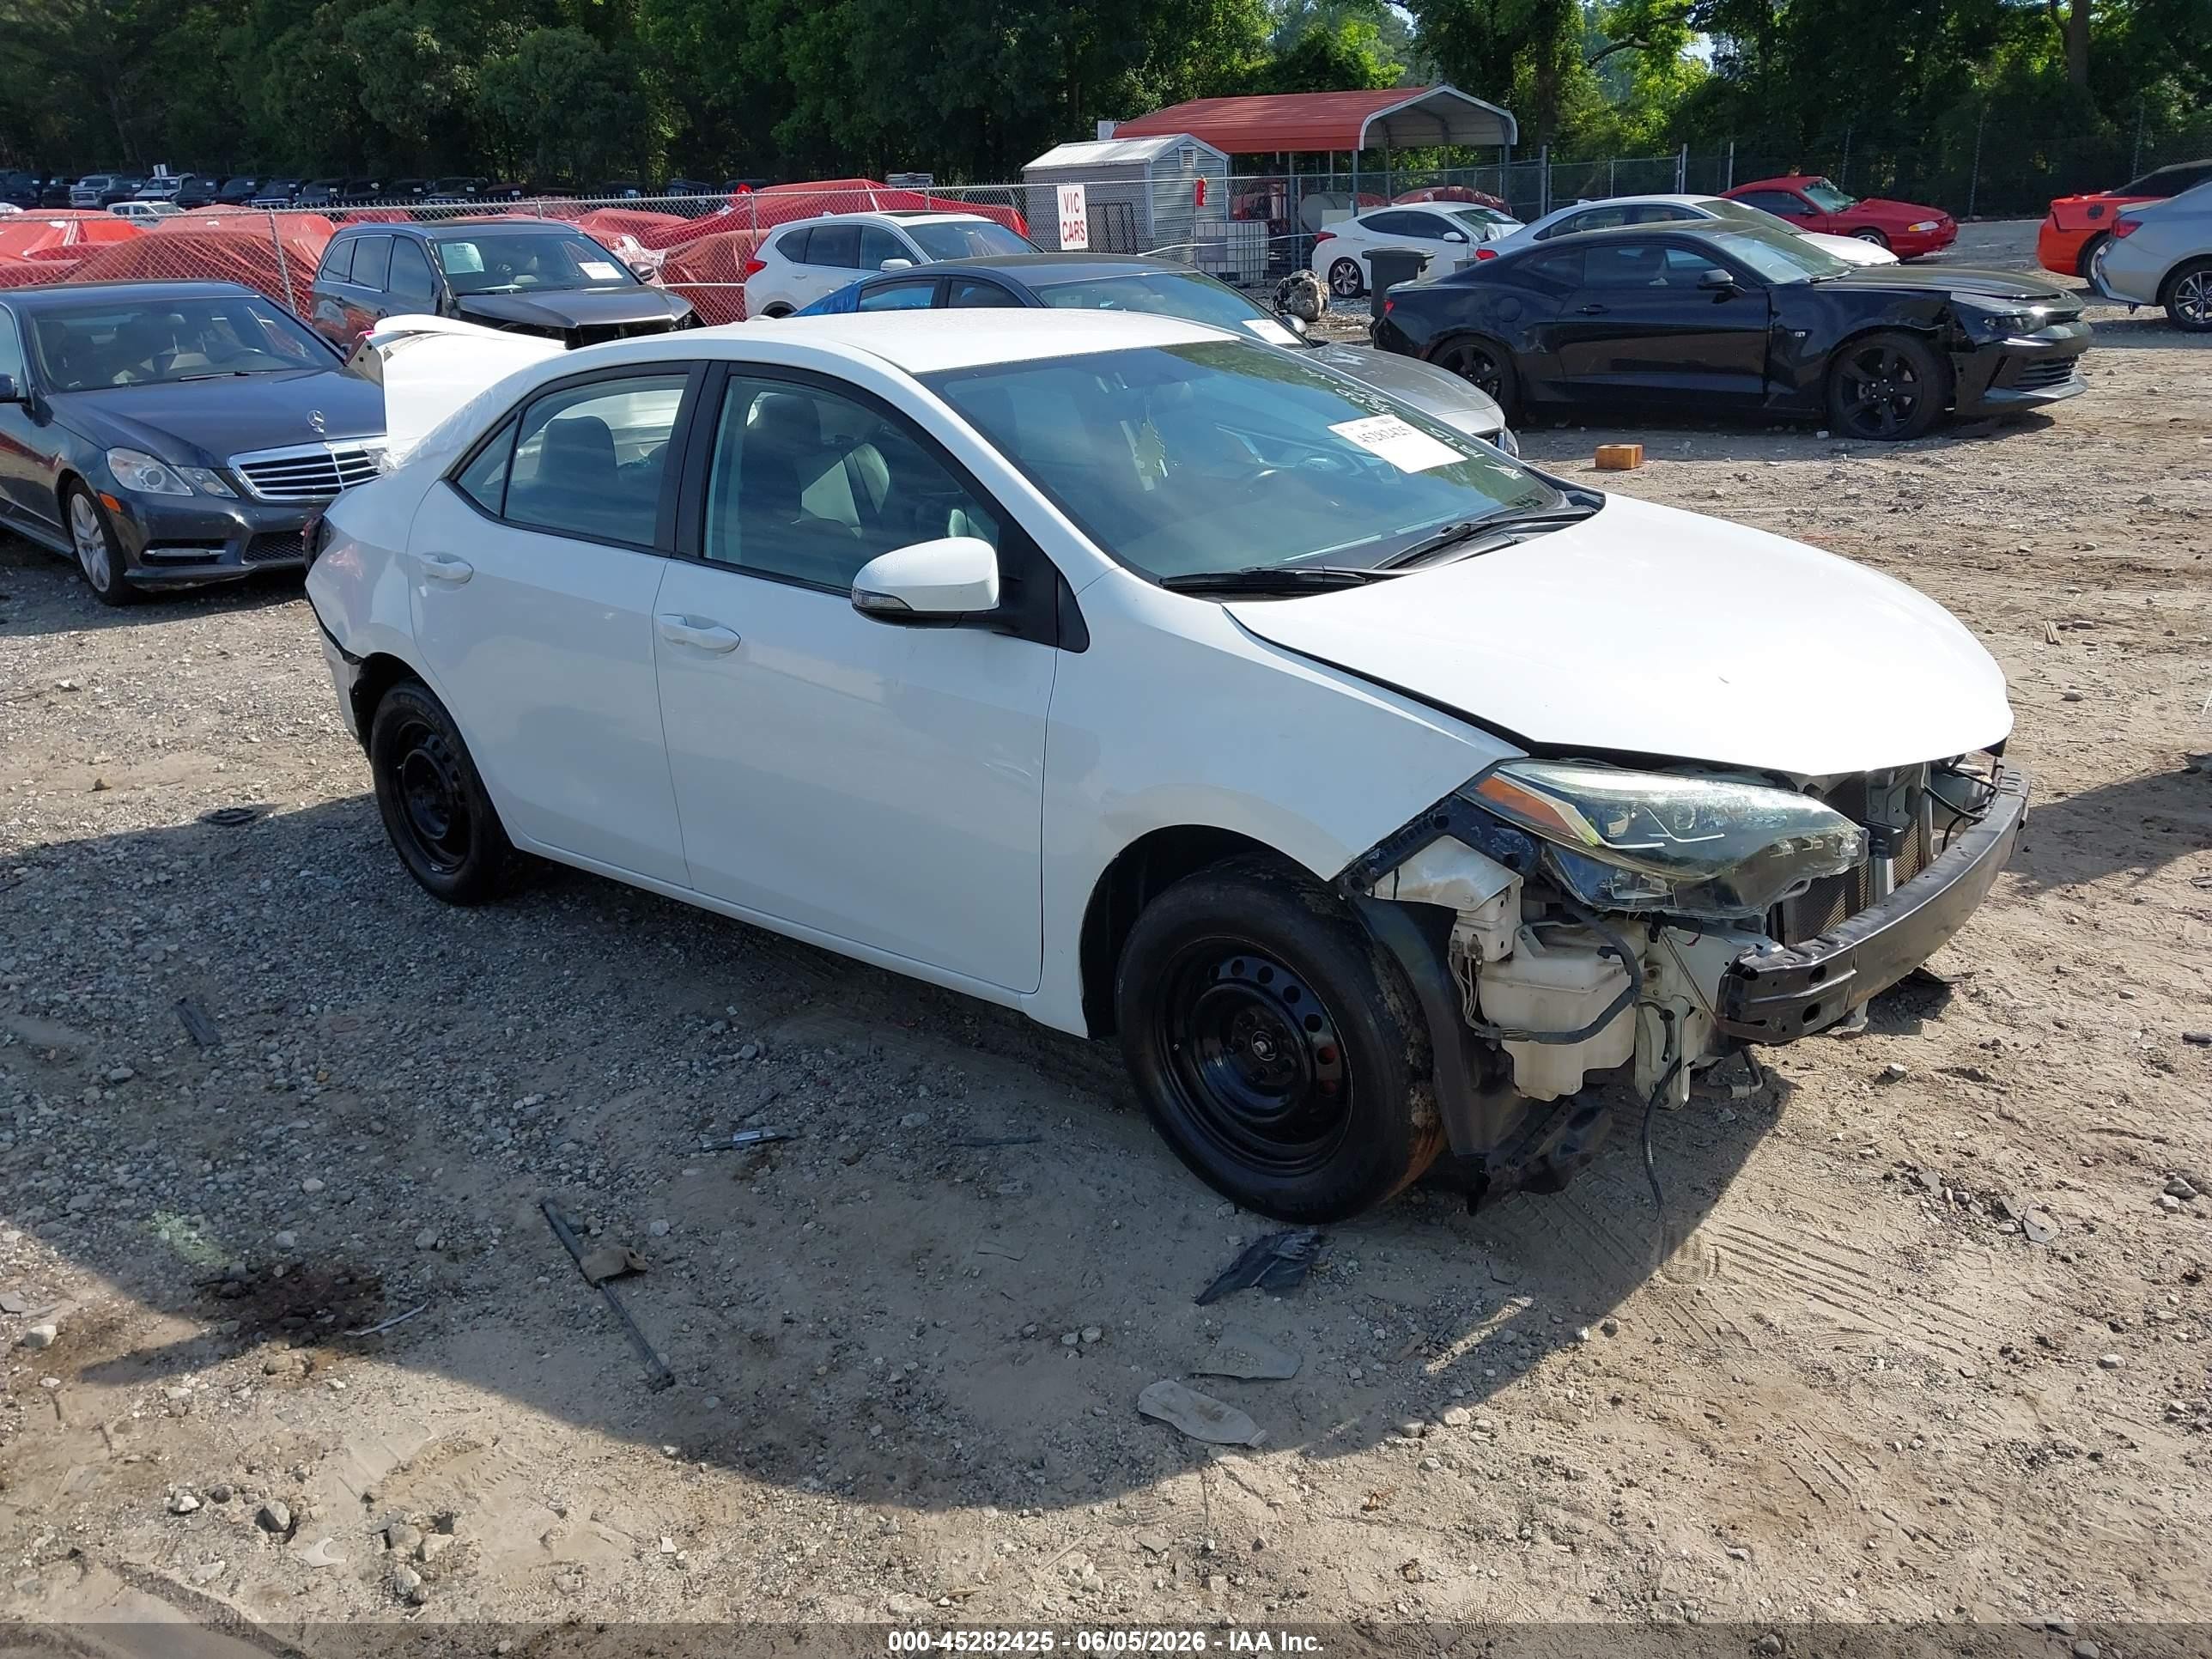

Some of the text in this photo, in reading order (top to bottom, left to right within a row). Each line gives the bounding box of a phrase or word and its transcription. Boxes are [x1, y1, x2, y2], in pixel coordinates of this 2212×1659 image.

[1063, 191, 1080, 214] VIC
[1062, 219, 1085, 242] CARS
[1358, 425, 1413, 443] 45282425
